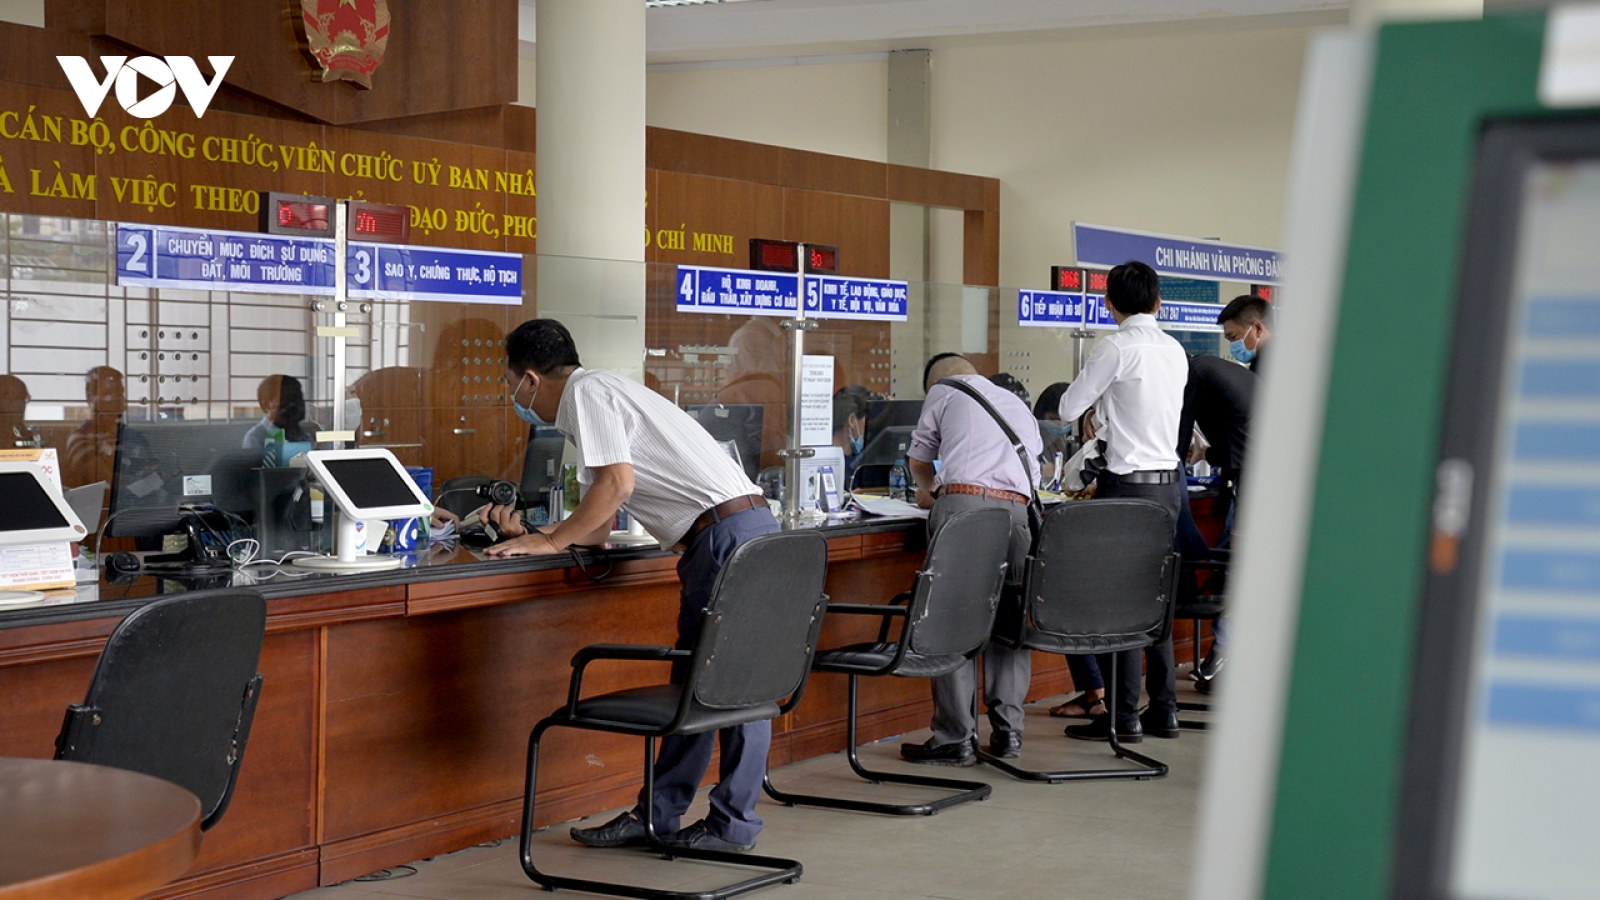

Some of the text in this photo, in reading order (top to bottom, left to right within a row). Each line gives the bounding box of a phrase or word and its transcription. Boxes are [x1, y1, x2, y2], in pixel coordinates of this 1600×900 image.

[0, 105, 537, 197] CÁN BỘ, CÔNG CHỨC, VIÊN CHỨC UỶ BAN NHÂ
[30, 160, 97, 200] LÀM
[110, 175, 176, 213] VIỆC
[191, 184, 260, 215] THEO
[455, 202, 500, 239] ĐỨC,
[656, 223, 686, 250] CHÍ
[693, 232, 734, 254] MINH
[126, 234, 147, 271] 2
[168, 234, 327, 267] CHUYỂN MỤC ĐÍCH SỬ DỤNG
[1156, 246, 1174, 266] CHI
[1175, 246, 1210, 270] NHÁNH
[1211, 250, 1230, 273] VĂN
[1233, 252, 1264, 275] PHÒNG
[201, 257, 302, 281] ĐẤT, MÔI TRƯỜNG
[354, 250, 371, 284] 3
[384, 260, 517, 286] SAO Y, CHỨNG THỰC, HỘ TỊCH
[680, 273, 693, 301] 4
[736, 278, 751, 290] KINH
[807, 281, 818, 308] 5
[740, 291, 753, 305] XÂY
[755, 294, 772, 309] DỰNG
[774, 295, 783, 307] CƠ
[1021, 295, 1030, 318] 6
[1034, 297, 1046, 315] TIẾP
[1065, 298, 1073, 315] HỒ
[1088, 299, 1096, 320] 7
[1170, 306, 1180, 320] 247
